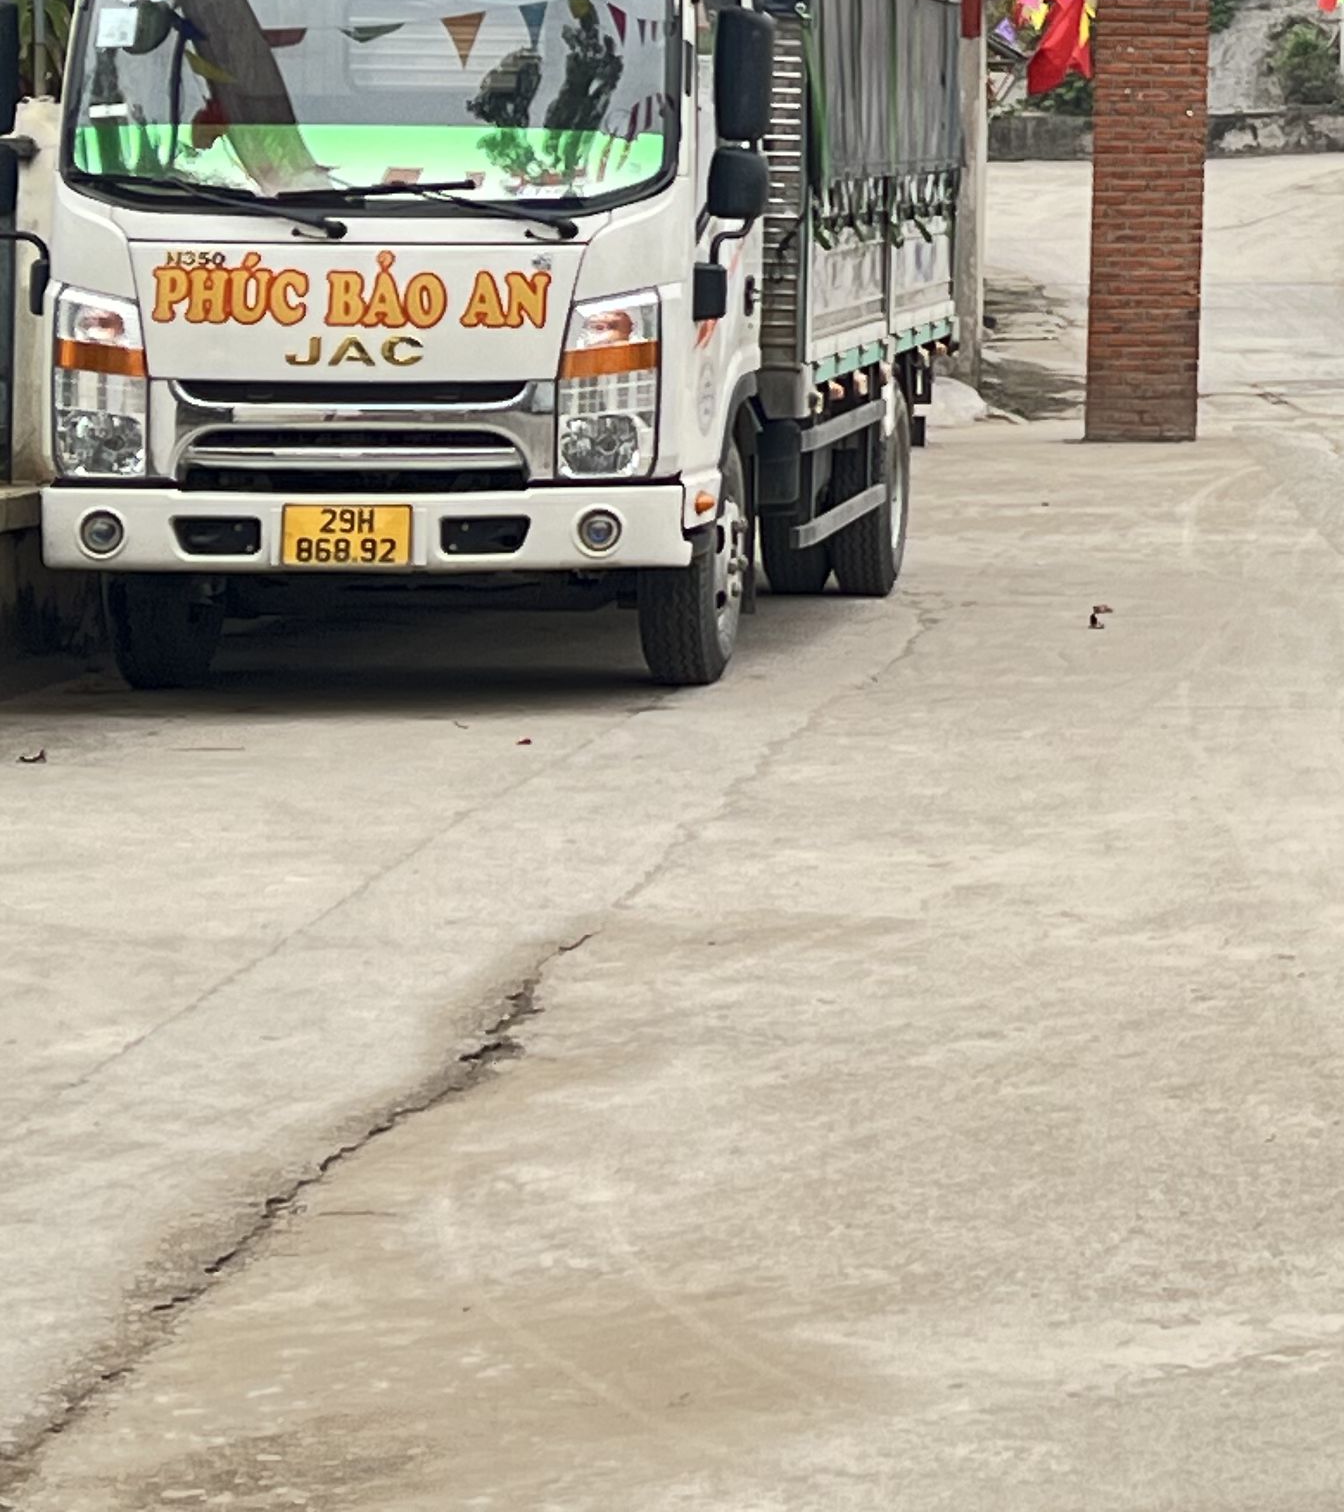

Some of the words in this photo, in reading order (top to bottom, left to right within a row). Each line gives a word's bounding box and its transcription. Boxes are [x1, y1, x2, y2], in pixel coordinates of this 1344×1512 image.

[152, 251, 309, 326] PHÚC
[324, 250, 448, 329] BẢO
[460, 270, 552, 329] AN
[284, 334, 425, 367] JAC
[319, 508, 374, 534] 29H
[296, 537, 396, 563] 868.92
